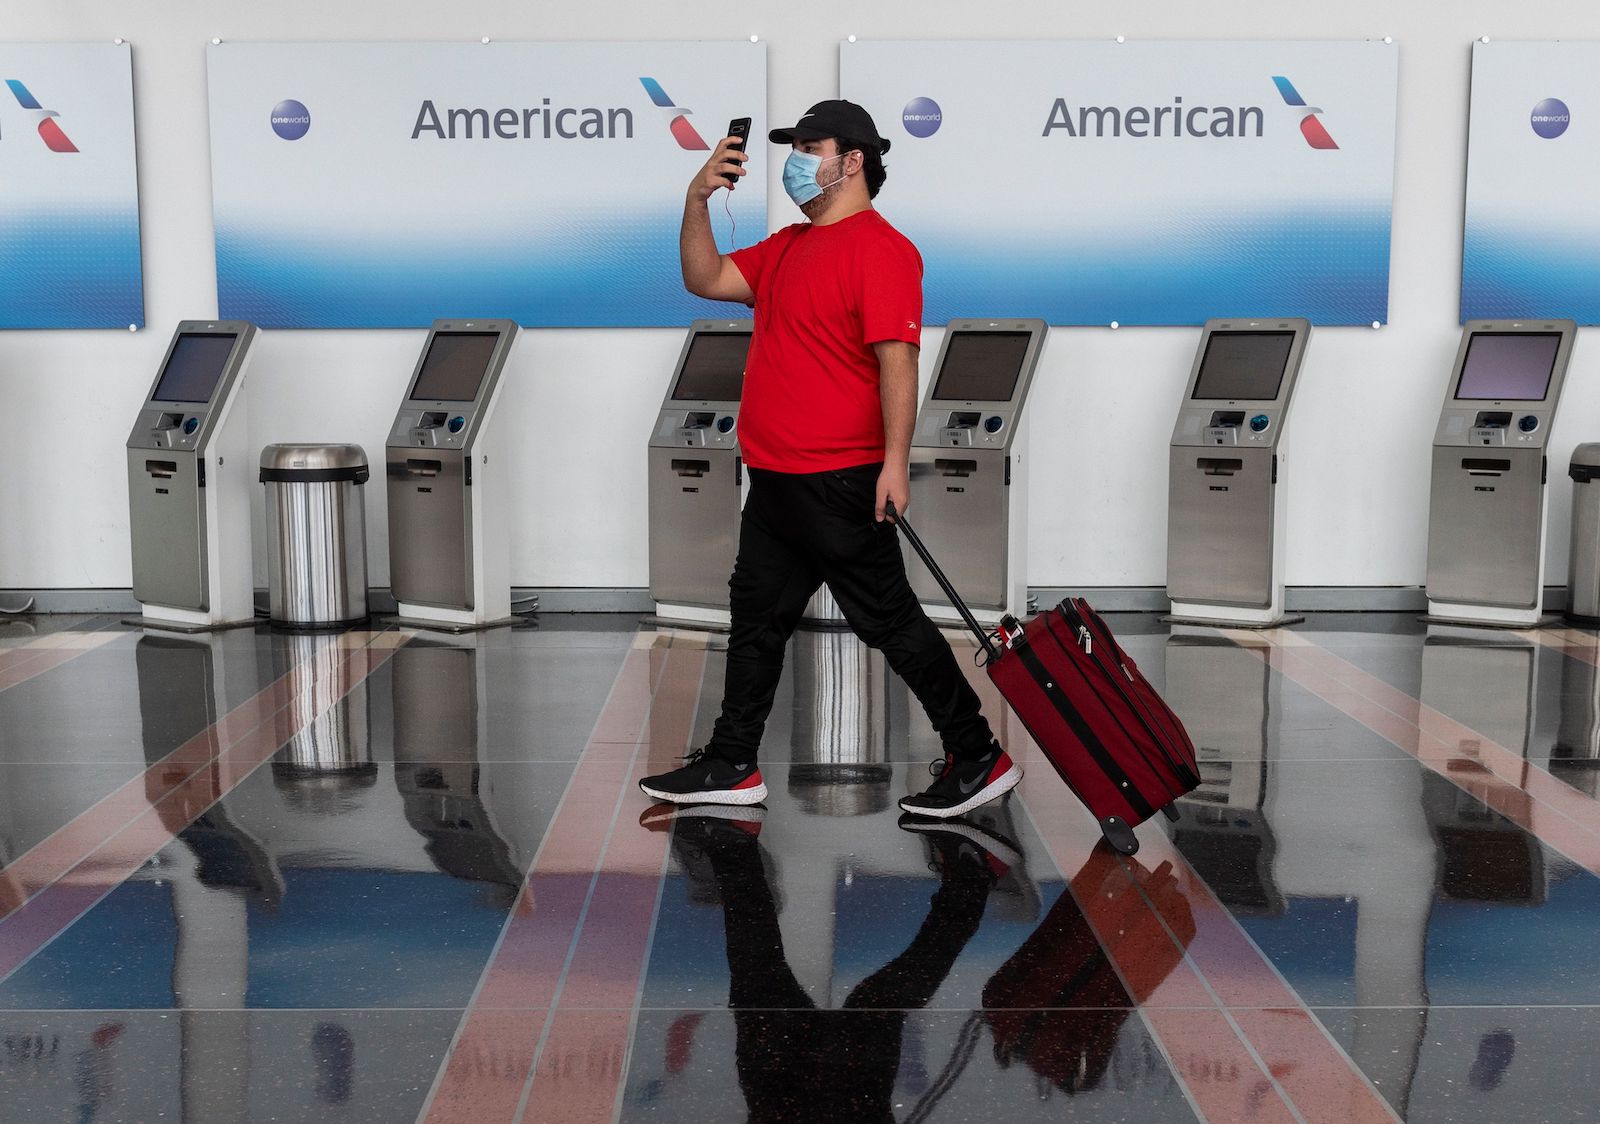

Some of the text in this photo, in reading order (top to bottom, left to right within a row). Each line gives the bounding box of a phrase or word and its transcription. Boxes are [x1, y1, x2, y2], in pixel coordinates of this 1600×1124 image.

[272, 115, 309, 124] oneworld
[411, 98, 633, 139] American
[903, 113, 941, 121] oneworld
[1042, 97, 1263, 138] American
[1532, 114, 1569, 122] oneworld
